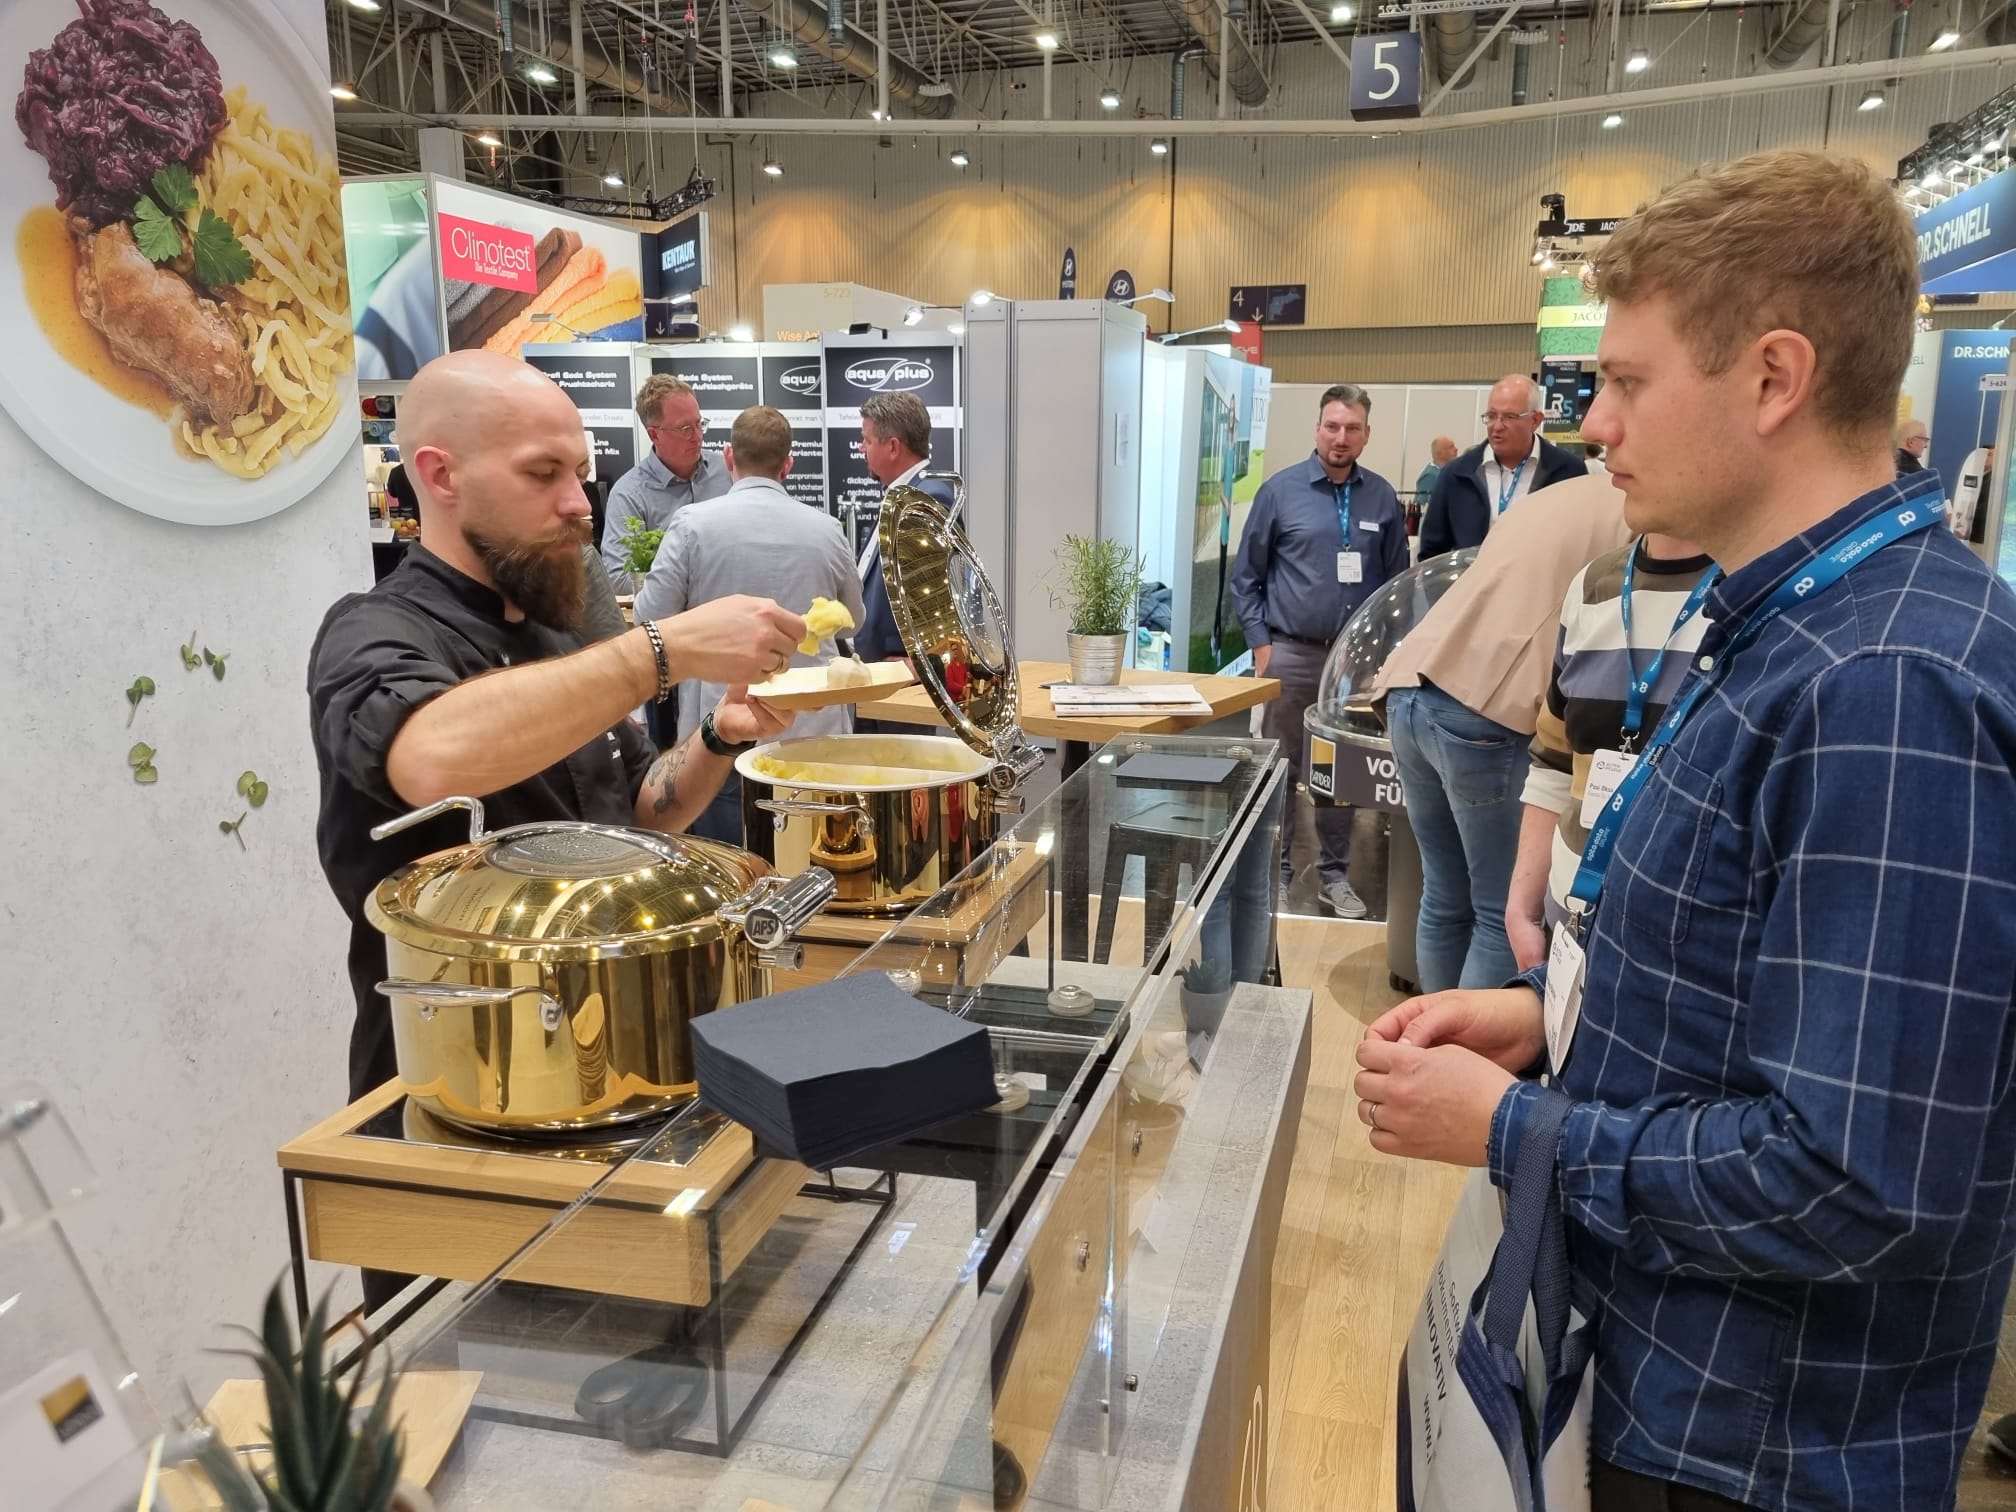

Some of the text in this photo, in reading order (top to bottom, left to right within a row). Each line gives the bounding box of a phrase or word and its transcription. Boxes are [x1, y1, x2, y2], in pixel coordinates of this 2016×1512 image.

[1368, 41, 1401, 101] 5
[1600, 222, 1618, 231] JACO
[1916, 203, 1991, 264] DR.SCHNELL
[451, 227, 531, 272] Clinotest
[662, 240, 695, 271] KENTAUR
[1233, 290, 1244, 307] 4
[1573, 310, 1606, 321] JACO
[777, 331, 801, 342] Wise
[1954, 346, 2010, 358] DR.SCHN
[585, 371, 617, 379] System
[700, 374, 733, 382] System
[782, 375, 815, 387] aqua
[847, 366, 929, 381] aqua plus
[1311, 768, 1332, 790] ANDER
[753, 919, 775, 936] APS
